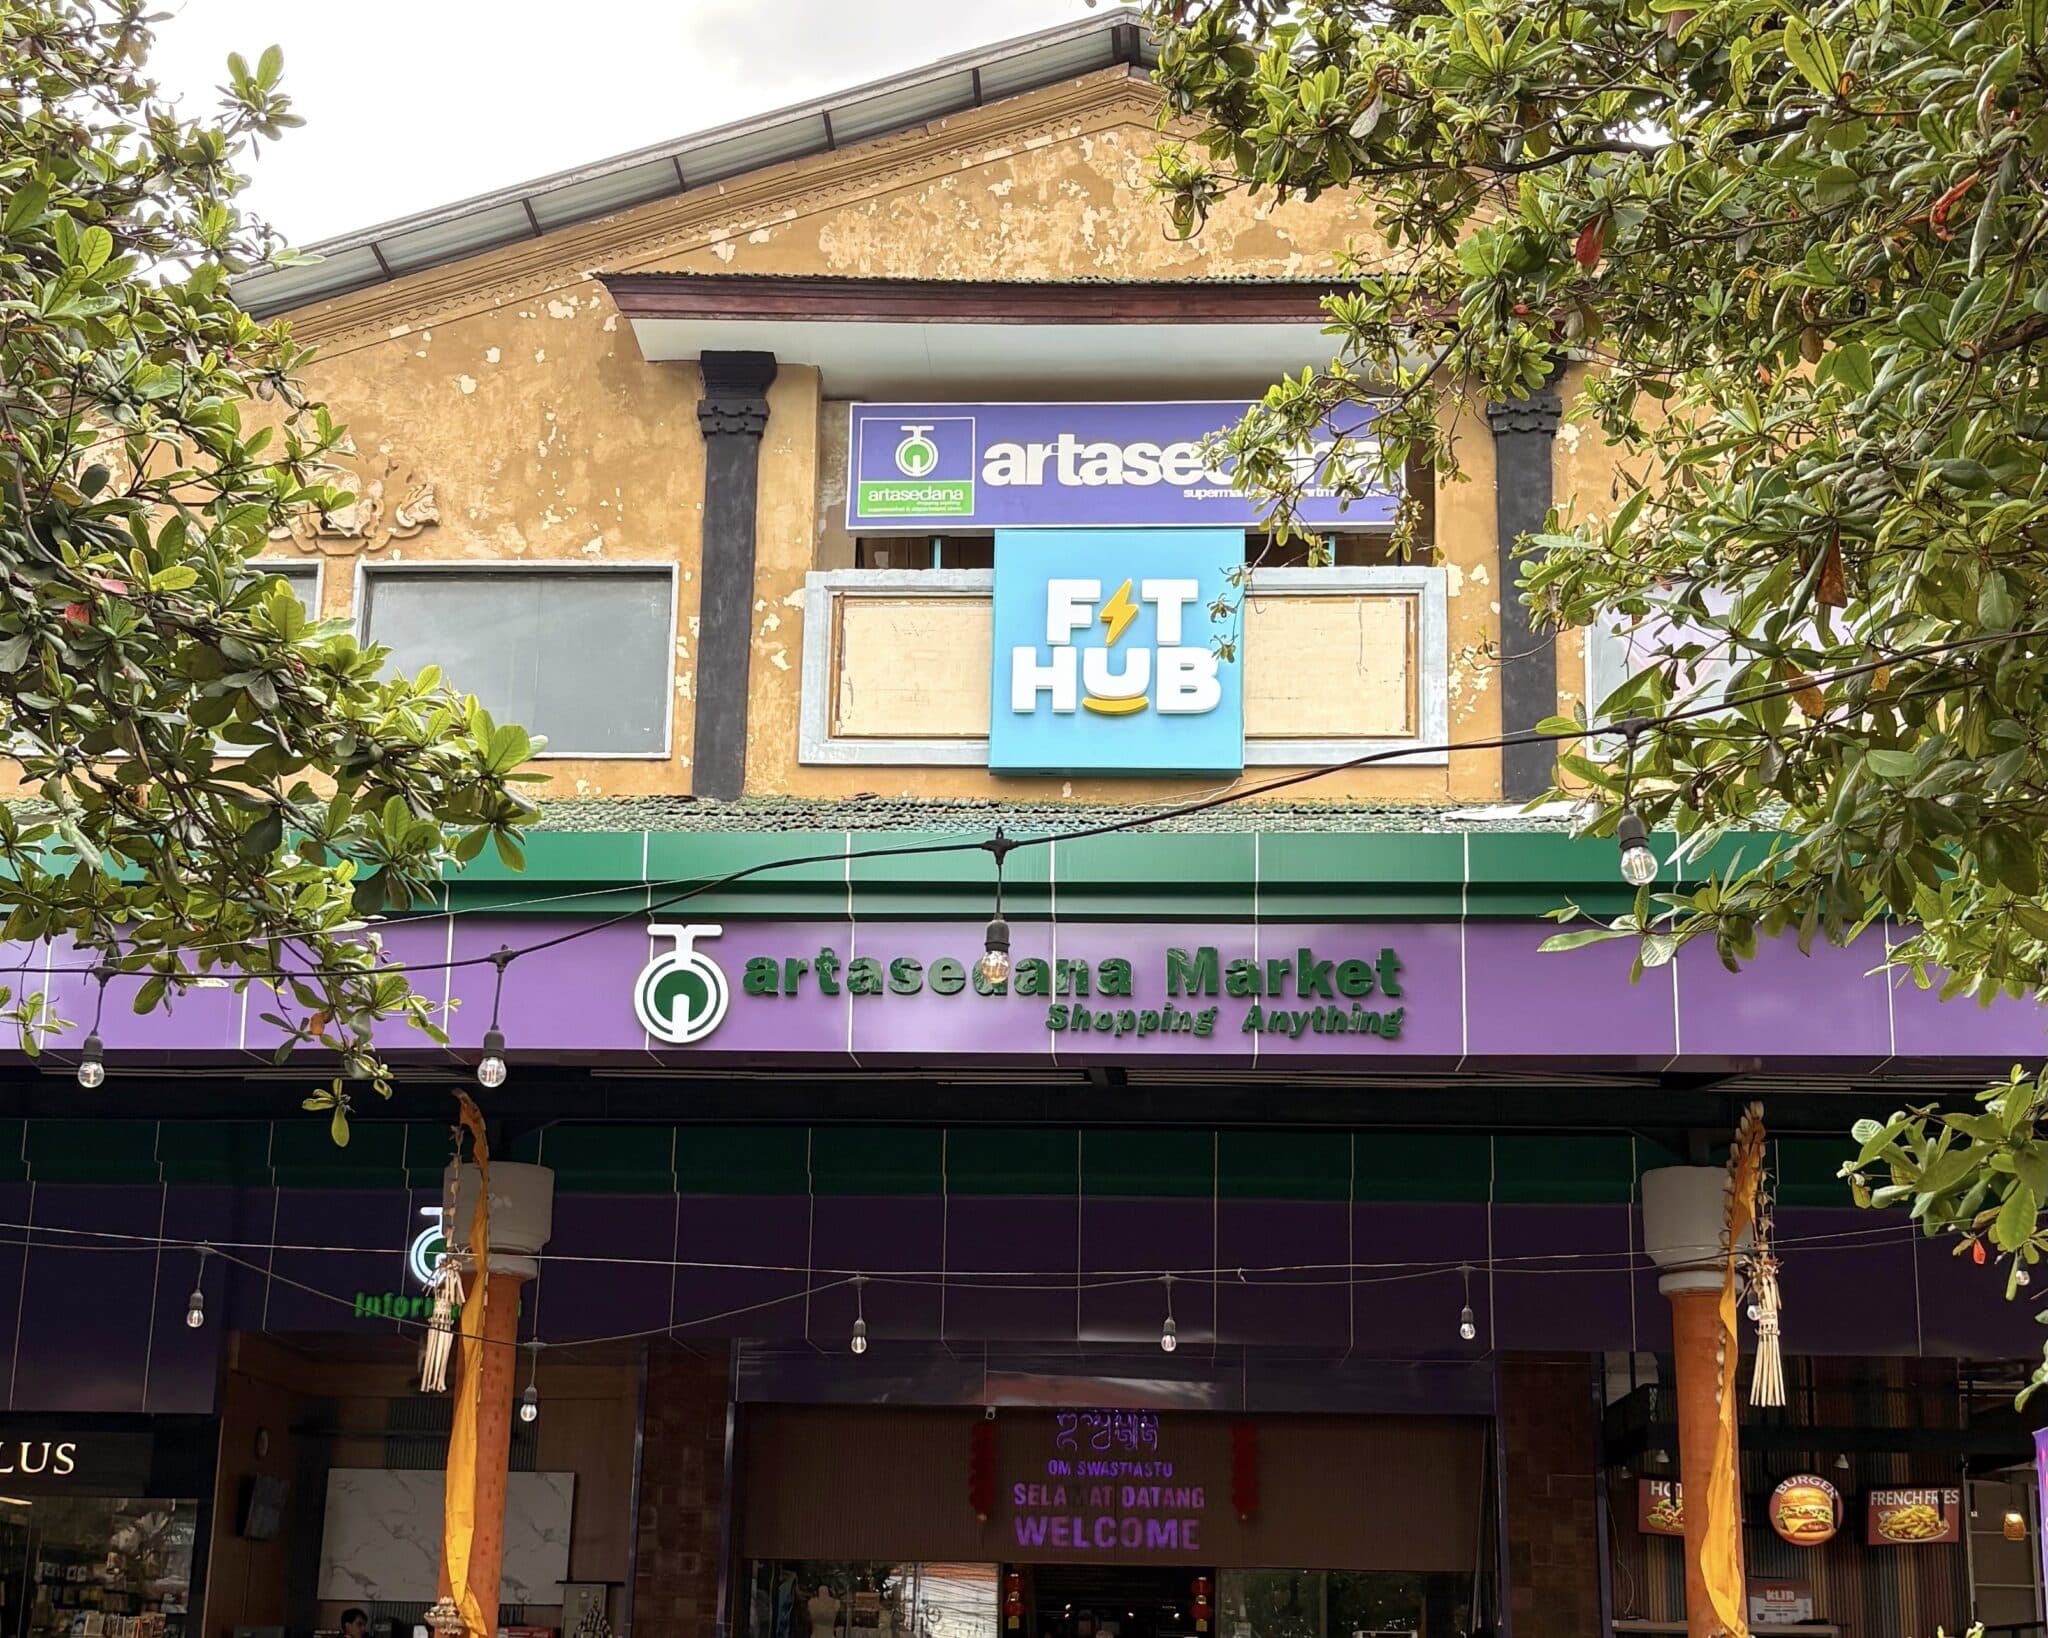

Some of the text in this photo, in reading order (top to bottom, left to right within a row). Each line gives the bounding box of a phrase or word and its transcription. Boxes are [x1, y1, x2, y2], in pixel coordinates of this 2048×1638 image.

[868, 485, 964, 501] artasedana
[1011, 646, 1223, 714] HUB
[1166, 946, 1403, 998] Market
[1045, 1002, 1404, 1039] Shopping Anything
[1048, 1459, 1173, 1477] OM SWASTIASTU
[1121, 1486, 1205, 1508] DATANG
[1774, 1475, 1839, 1499] BURGER
[1870, 1489, 1960, 1506] FRENCH FRES
[1014, 1515, 1201, 1550] WELCOME
